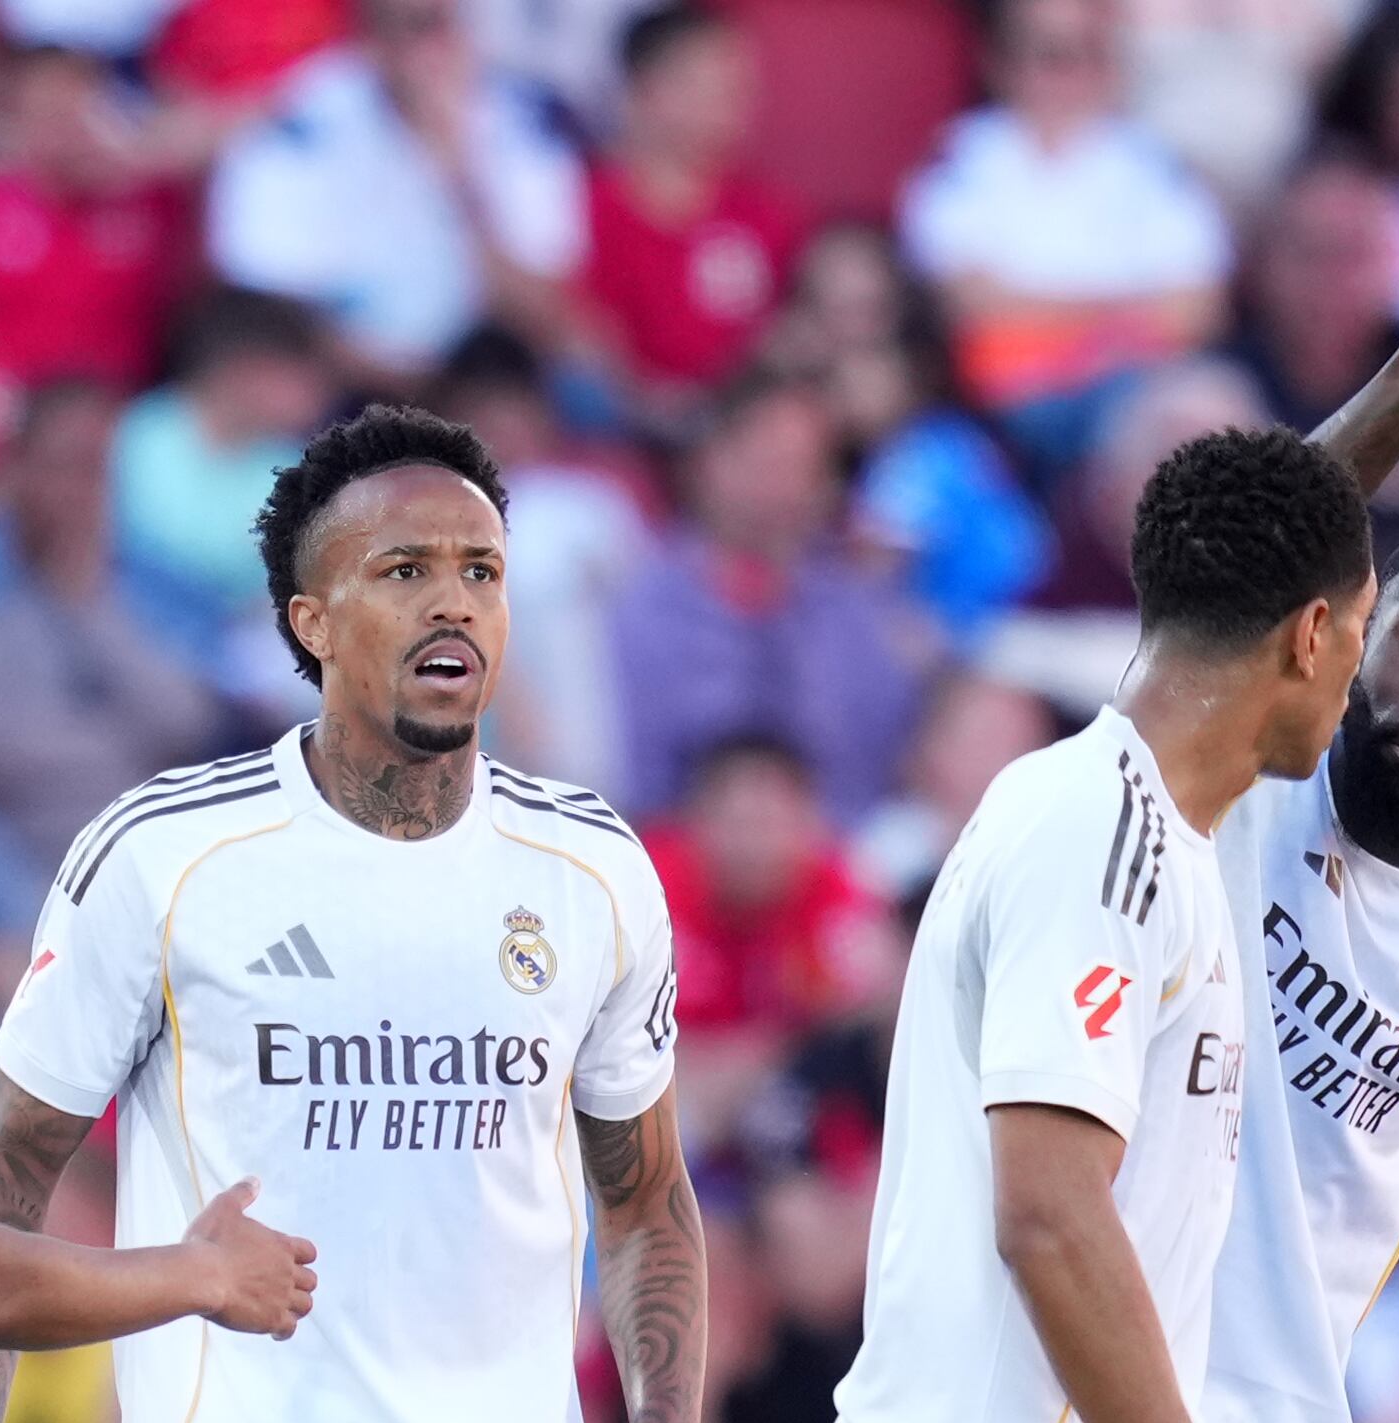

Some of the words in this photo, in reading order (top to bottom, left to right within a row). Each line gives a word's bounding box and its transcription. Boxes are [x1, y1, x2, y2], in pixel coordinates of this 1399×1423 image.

[253, 1019, 551, 1087] Emirates
[303, 1099, 369, 1151] FLY
[382, 1098, 507, 1151] BETTER
